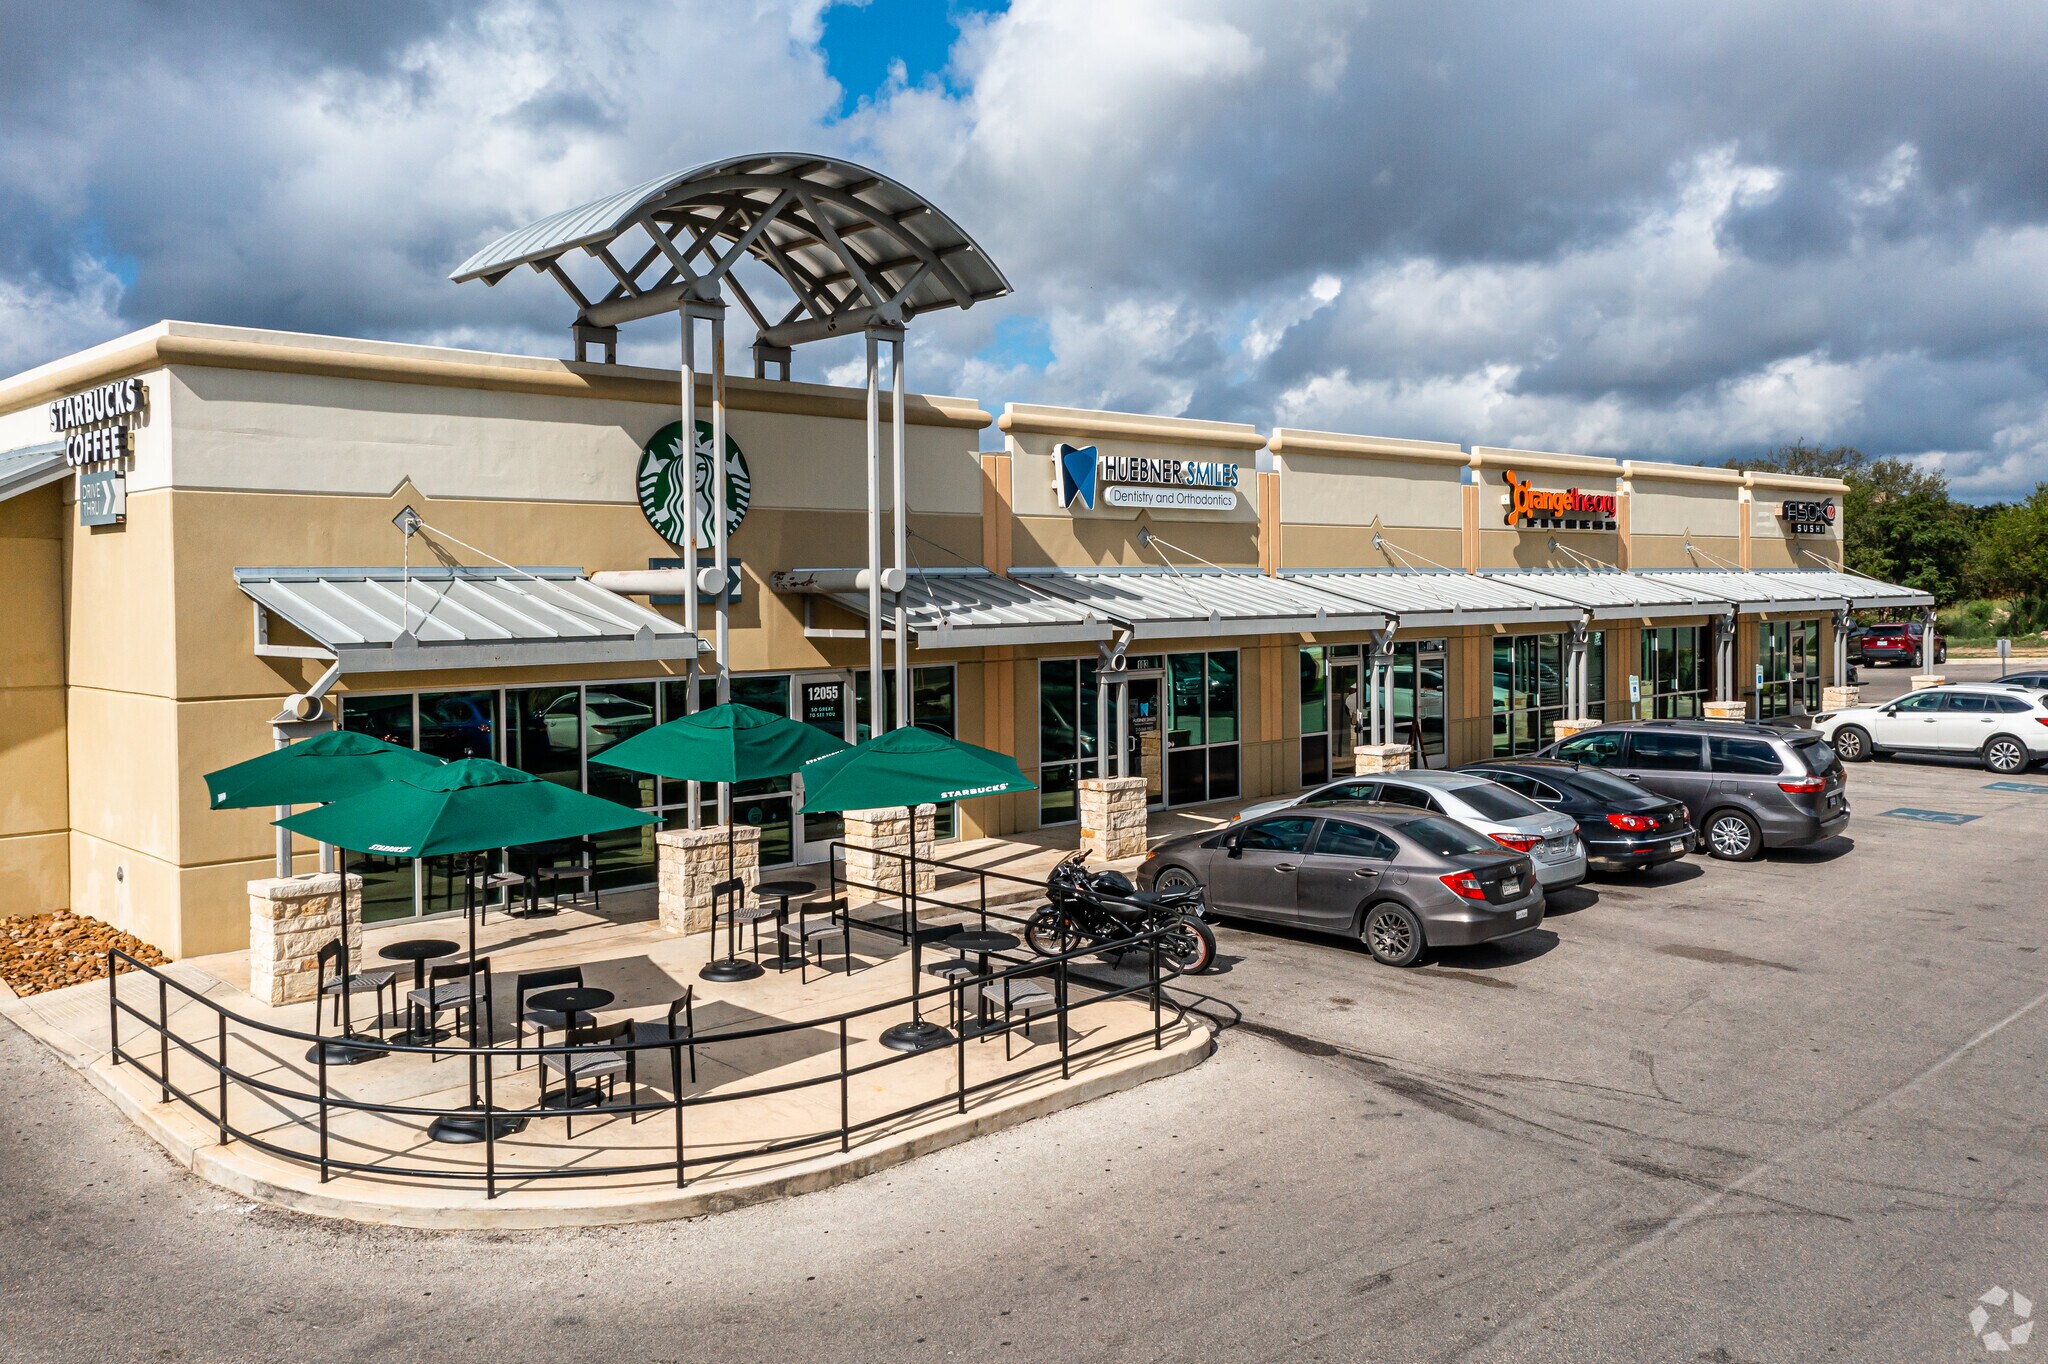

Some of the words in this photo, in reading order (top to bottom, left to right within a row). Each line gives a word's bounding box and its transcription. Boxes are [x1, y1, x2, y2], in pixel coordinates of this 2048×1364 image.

[50, 378, 139, 432] STARBUCKS
[66, 426, 122, 467] COFFEE
[1105, 456, 1182, 484] HUEBNER
[1186, 461, 1240, 487] SMILES
[82, 482, 101, 500] DRIVE
[1114, 490, 1153, 504] Dentistry
[1155, 491, 1174, 504] and
[1176, 492, 1232, 506] Orthodontics
[82, 501, 100, 516] THRU
[1796, 524, 1825, 534] SUSHI
[808, 685, 838, 701] 12055
[940, 782, 1007, 799] STARBUCKS
